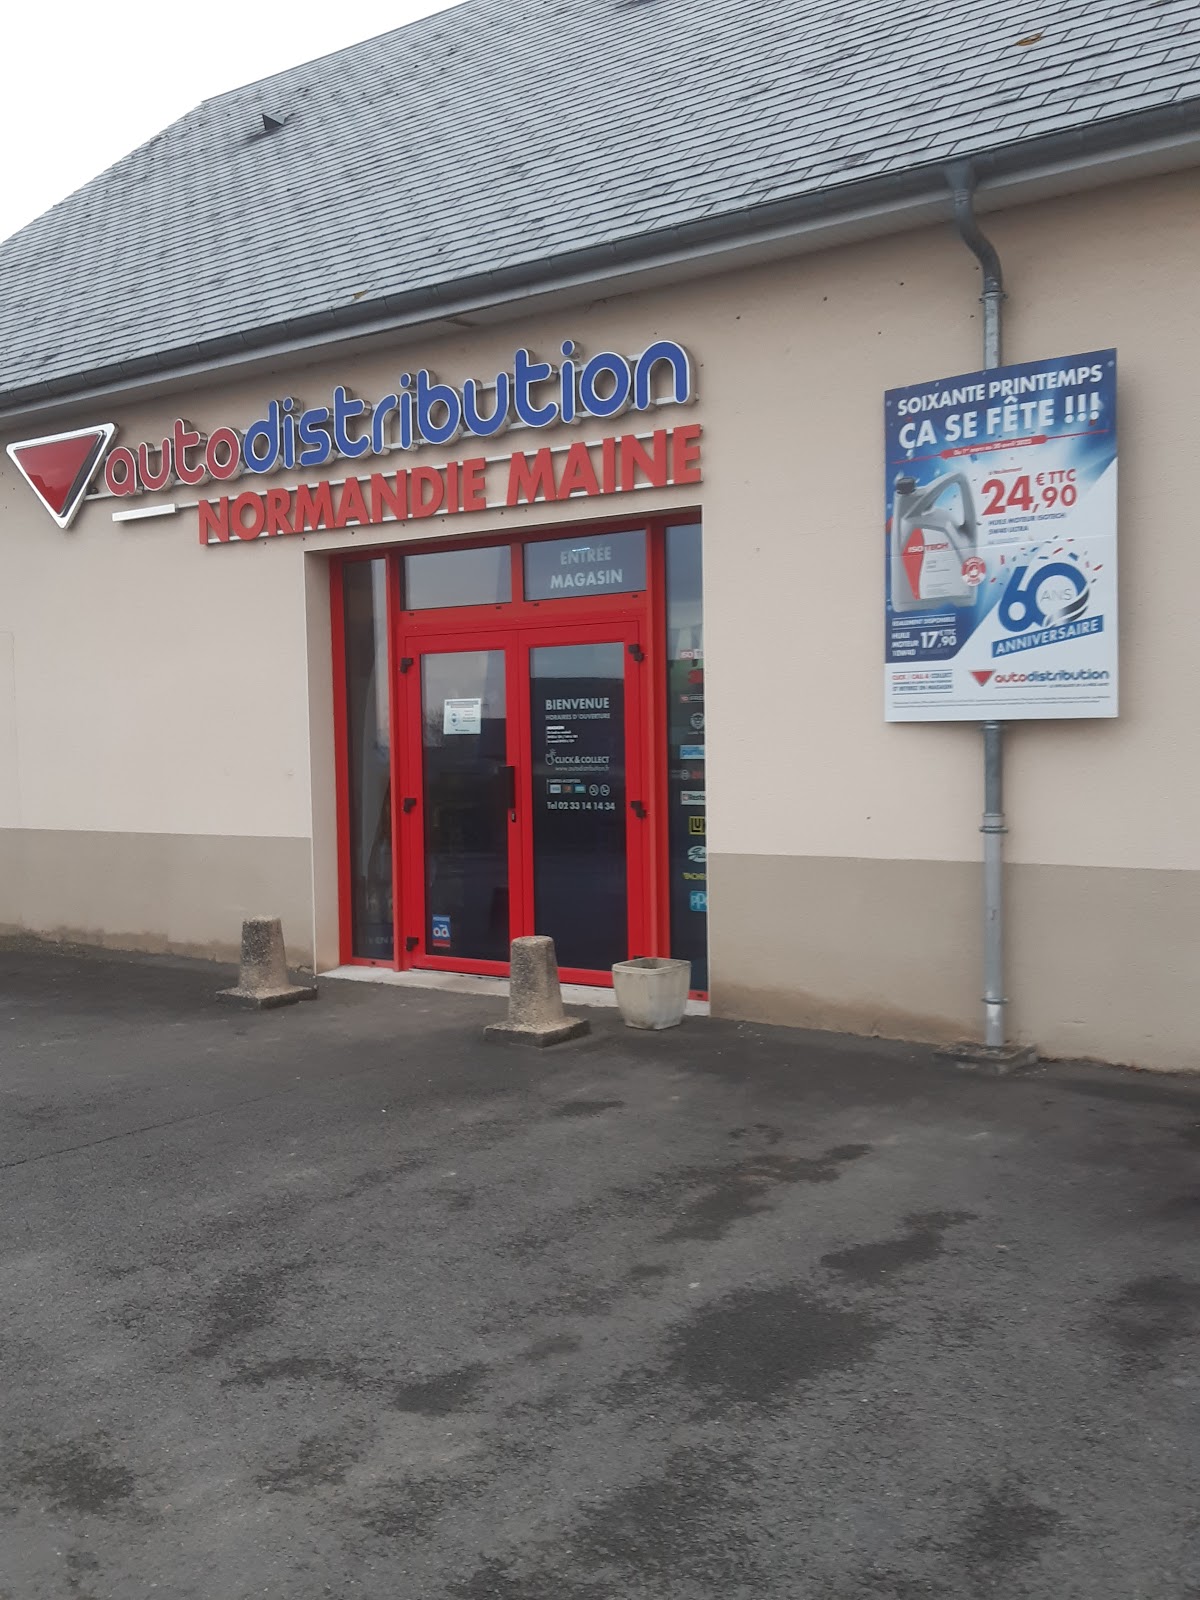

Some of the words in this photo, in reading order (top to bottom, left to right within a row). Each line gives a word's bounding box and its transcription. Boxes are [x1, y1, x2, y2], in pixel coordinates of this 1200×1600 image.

[897, 383, 985, 416] SOIXANTE
[989, 364, 1103, 399] PRINTEMPS
[104, 339, 690, 497] autodistribution
[899, 419, 938, 460] ÇA
[944, 411, 978, 443] SE
[986, 395, 1055, 435] FÊTE
[1064, 391, 1100, 425] !!!
[198, 457, 486, 545] NORMANDIE
[506, 423, 702, 506] MAINE
[1048, 468, 1077, 485] TTC
[550, 569, 623, 589] MAGASIN
[1041, 588, 1073, 602] ANS
[995, 619, 1100, 655] ANNIVERSAIRE
[994, 669, 1110, 684] autodistribution
[545, 698, 610, 711] BIENVENUE
[555, 756, 574, 764] CLICK
[574, 755, 581, 764] &
[581, 755, 610, 764] COLLECT
[558, 801, 569, 810] 02
[569, 801, 580, 810] 33
[581, 801, 592, 810] 14
[593, 801, 604, 810] 14
[604, 802, 616, 811] 34
